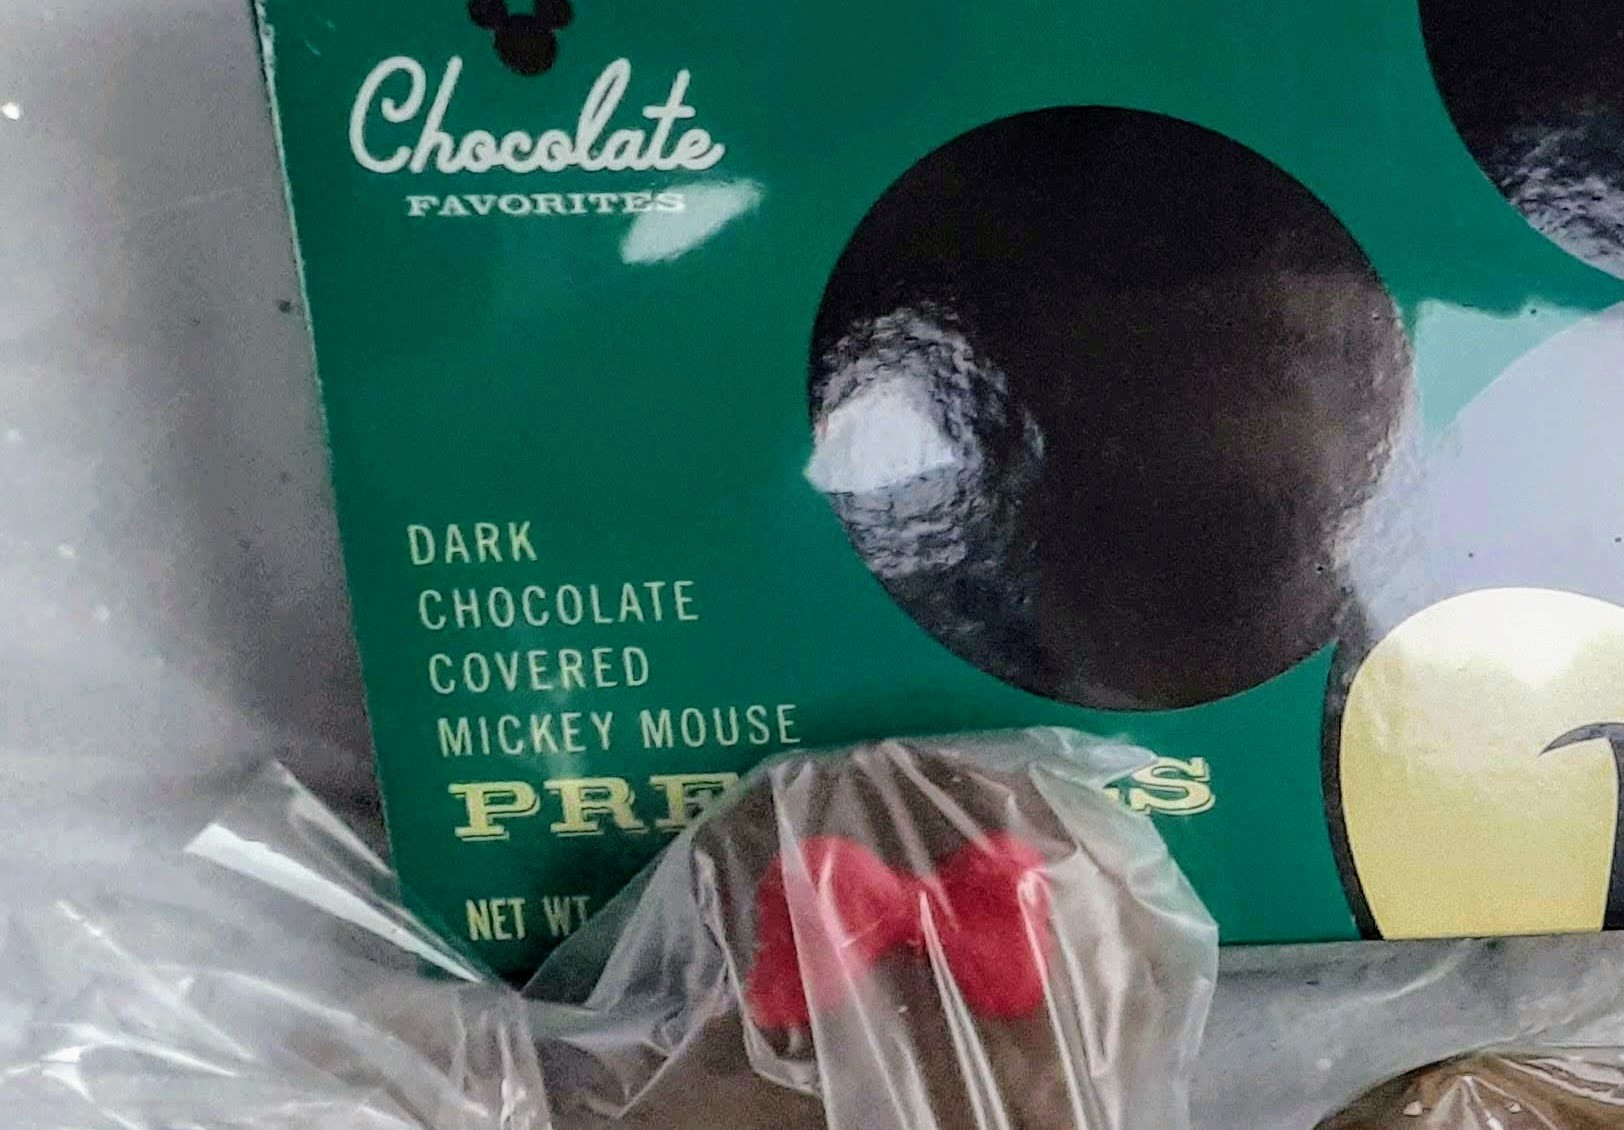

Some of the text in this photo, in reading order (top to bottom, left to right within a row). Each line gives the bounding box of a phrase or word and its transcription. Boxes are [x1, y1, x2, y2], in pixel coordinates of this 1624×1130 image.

[349, 55, 725, 174] Chocolate
[405, 191, 686, 217] FAVORITES
[407, 521, 538, 565] DARK
[418, 580, 698, 630] CHOCOLATE
[428, 647, 650, 694] COVERED
[437, 704, 801, 757] MICKEY MOUSE
[465, 898, 526, 941] NET
